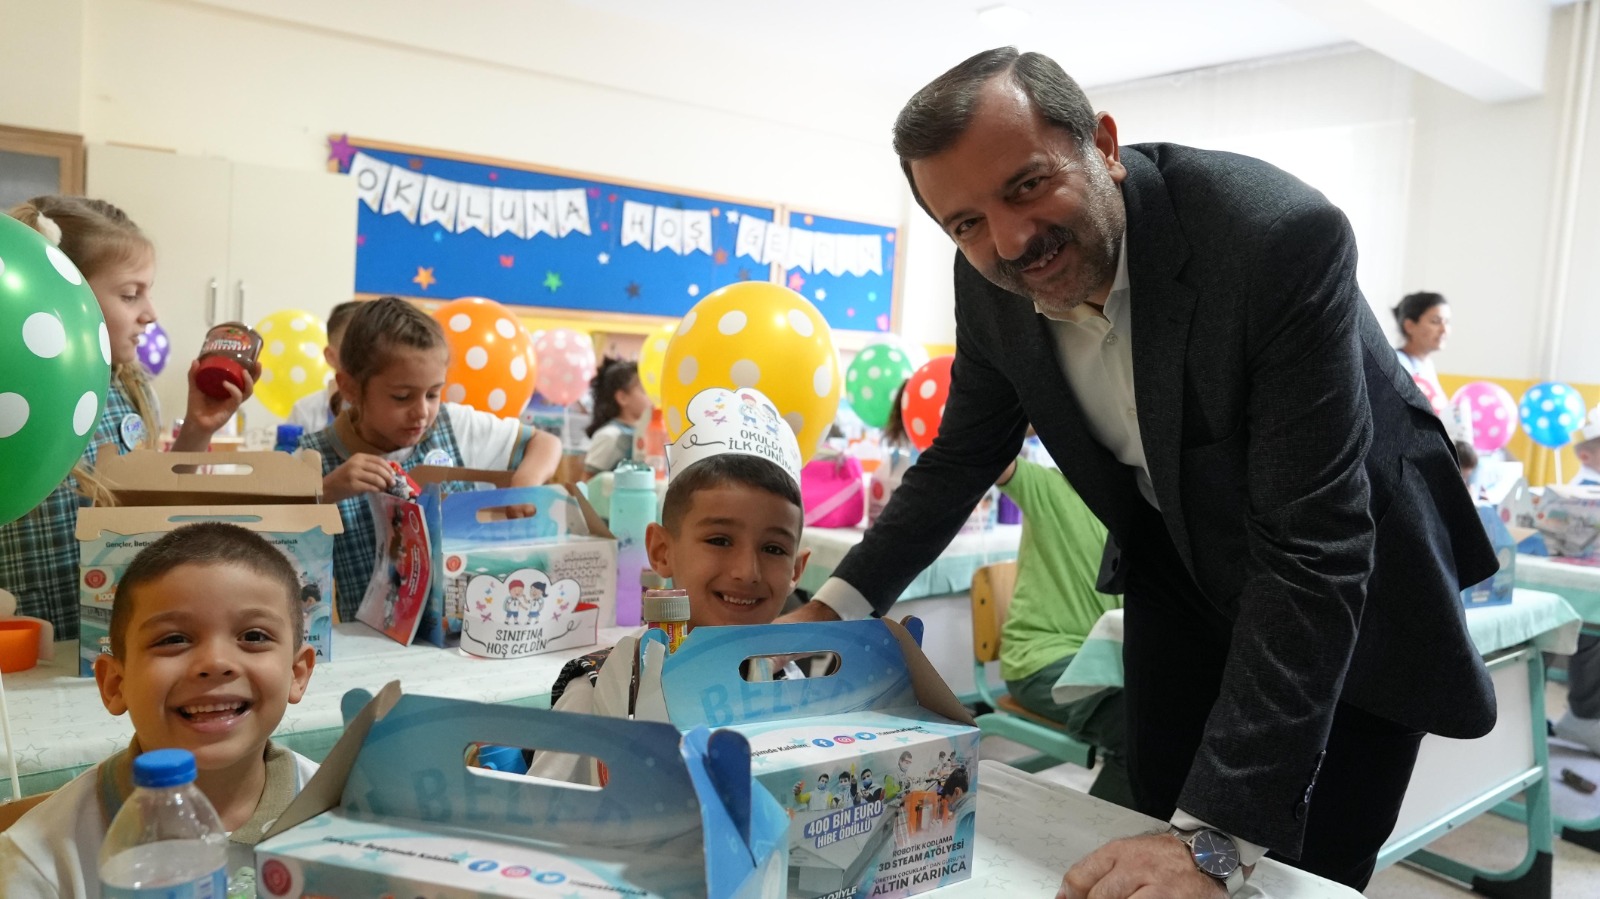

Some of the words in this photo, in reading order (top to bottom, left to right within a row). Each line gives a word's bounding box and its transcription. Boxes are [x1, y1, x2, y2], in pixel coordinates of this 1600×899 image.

[358, 168, 583, 222] OKULUNA
[631, 214, 704, 246] HOŞ
[728, 437, 752, 451] İLK
[740, 429, 784, 457] OKULDA
[486, 641, 508, 658] HOŞ
[511, 638, 548, 655] GELDİN
[495, 627, 543, 642] SINIFINA
[807, 817, 830, 836] 400
[832, 808, 852, 829] BİN
[854, 800, 882, 821] EURO
[817, 830, 838, 848] HİBE
[838, 817, 872, 840] ÖDÜLLÜ
[878, 862, 891, 872] 3D
[892, 853, 923, 868] STEAM
[923, 838, 965, 860] ATÖLYESİ
[892, 842, 921, 857] ROBOTİK
[921, 835, 953, 849] KODLAMA
[872, 877, 909, 897] ALTIN
[912, 861, 967, 886] KARINCA
